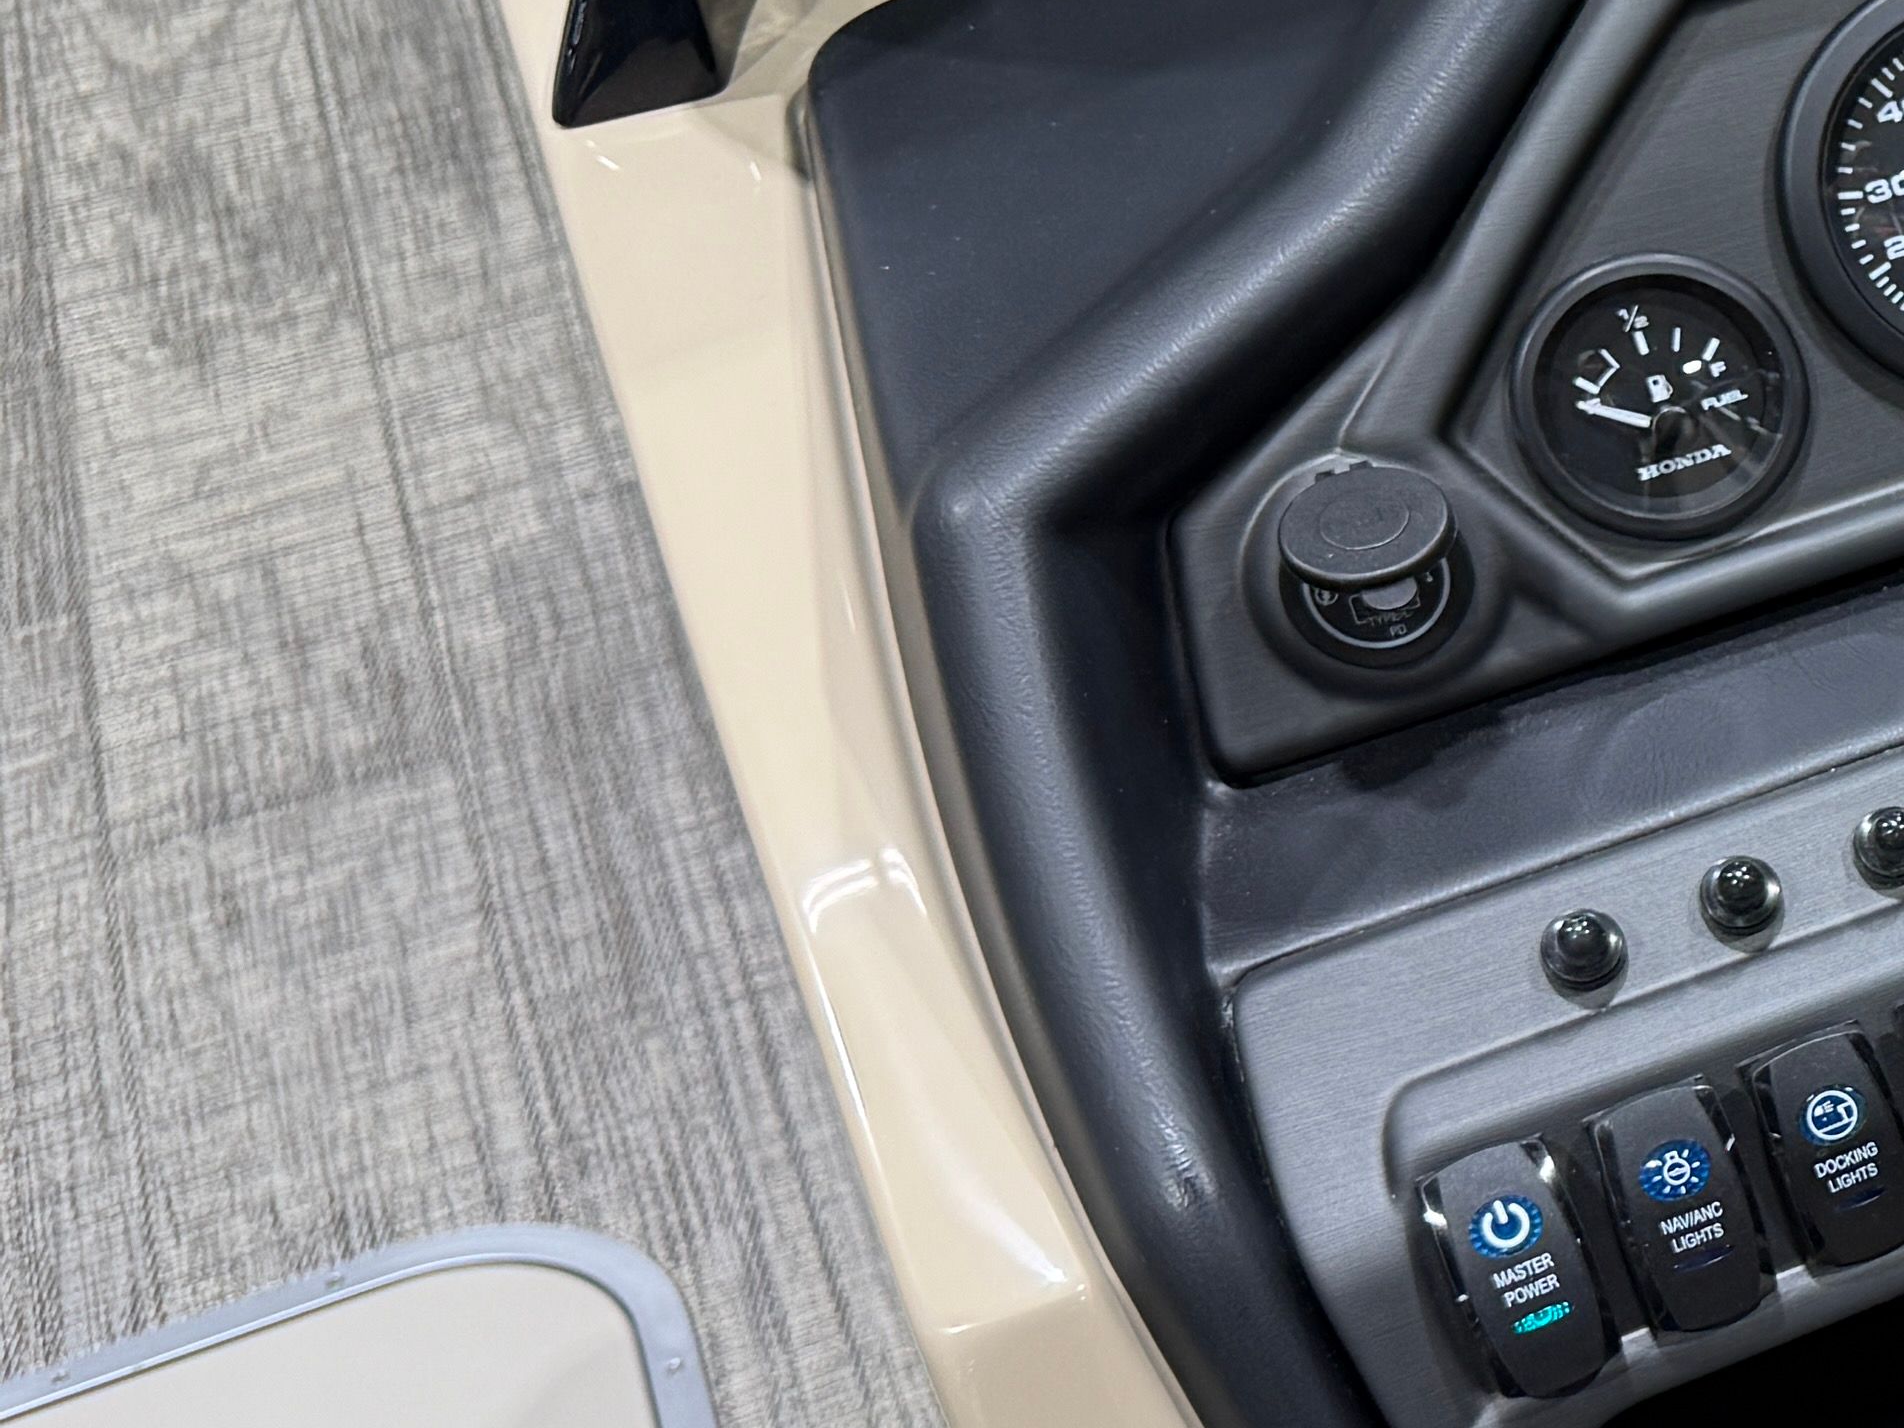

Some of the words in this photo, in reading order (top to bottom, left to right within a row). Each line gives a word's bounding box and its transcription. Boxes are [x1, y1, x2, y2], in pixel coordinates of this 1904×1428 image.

[1709, 361, 1727, 378] F
[1701, 389, 1749, 411] FUEL
[1635, 443, 1732, 482] HONDA
[1814, 1141, 1879, 1179] DOCKING
[1827, 1163, 1879, 1194] LIGHTS
[1660, 1201, 1724, 1236] NAV/ANC
[1671, 1222, 1725, 1254] LIGHTS
[1492, 1252, 1555, 1289] MASTER
[1503, 1273, 1560, 1308] POWER
